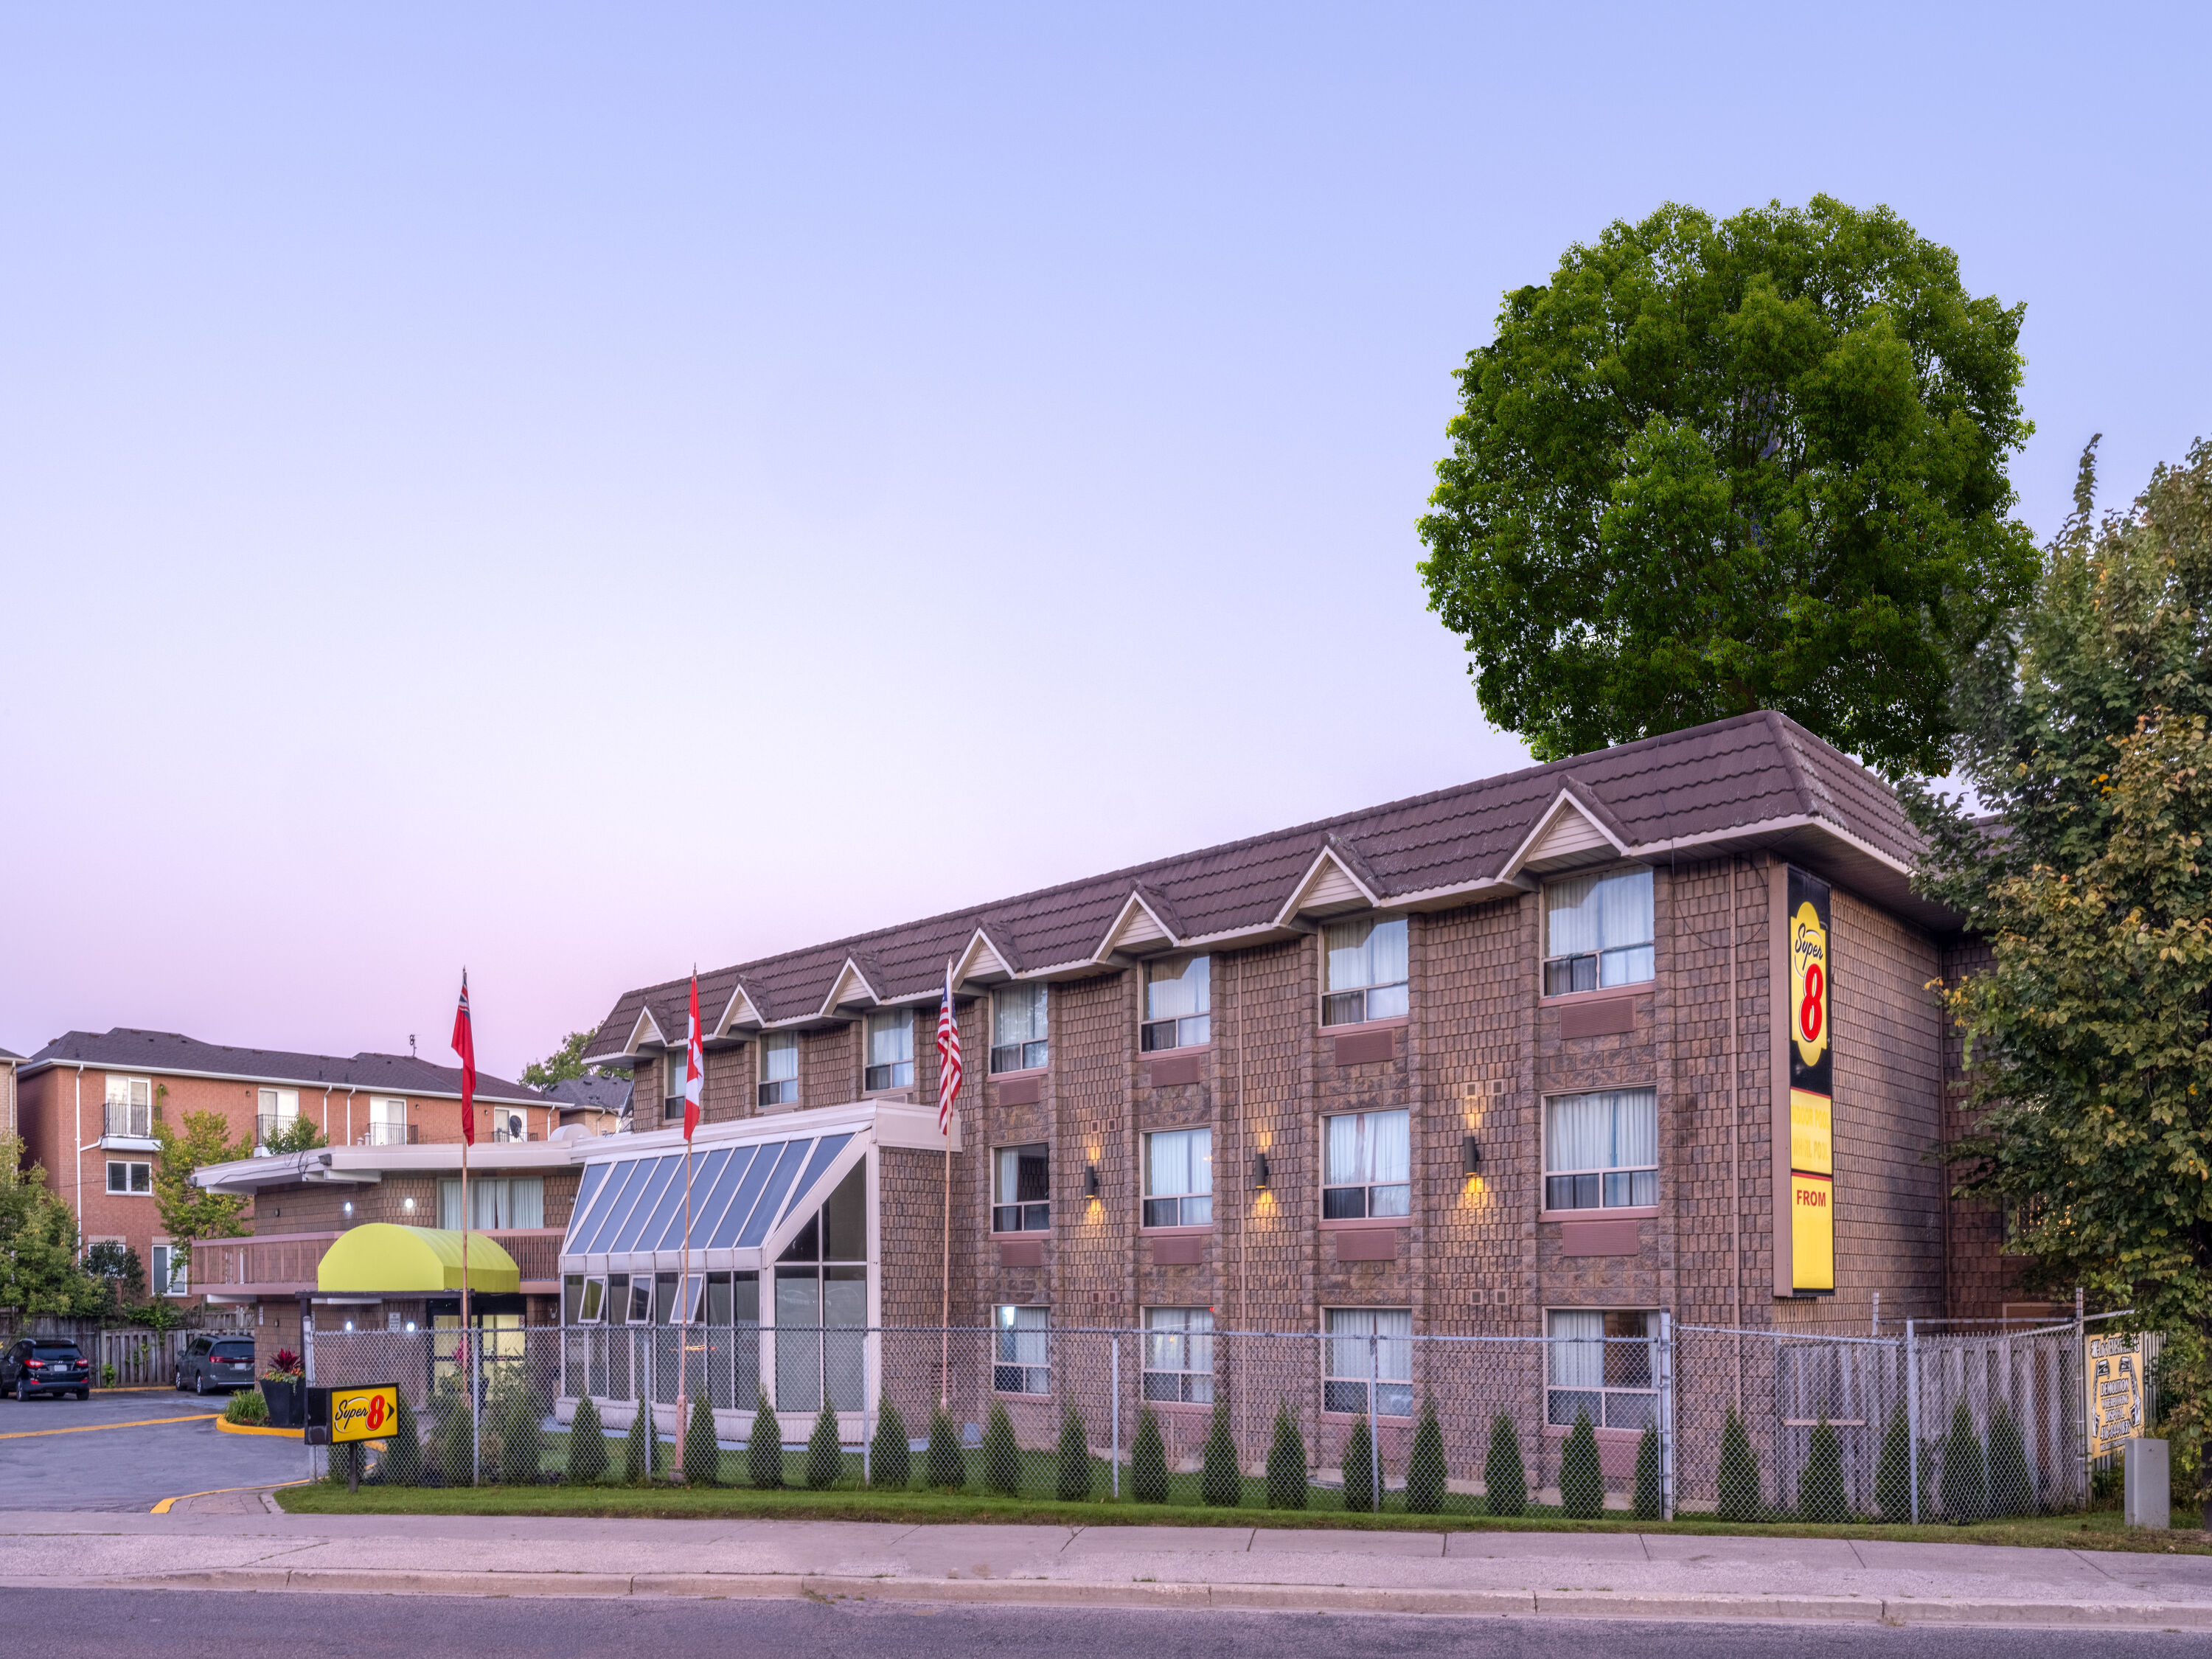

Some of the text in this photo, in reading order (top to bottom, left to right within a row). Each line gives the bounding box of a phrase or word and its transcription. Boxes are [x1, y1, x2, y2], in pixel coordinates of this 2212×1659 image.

[1795, 922, 1823, 971] Super
[1799, 963, 1823, 1043] 8
[1796, 1189, 1826, 1207] FROM
[2100, 1378, 2129, 1397] DEMOLITION
[334, 1394, 385, 1431] Super 8
